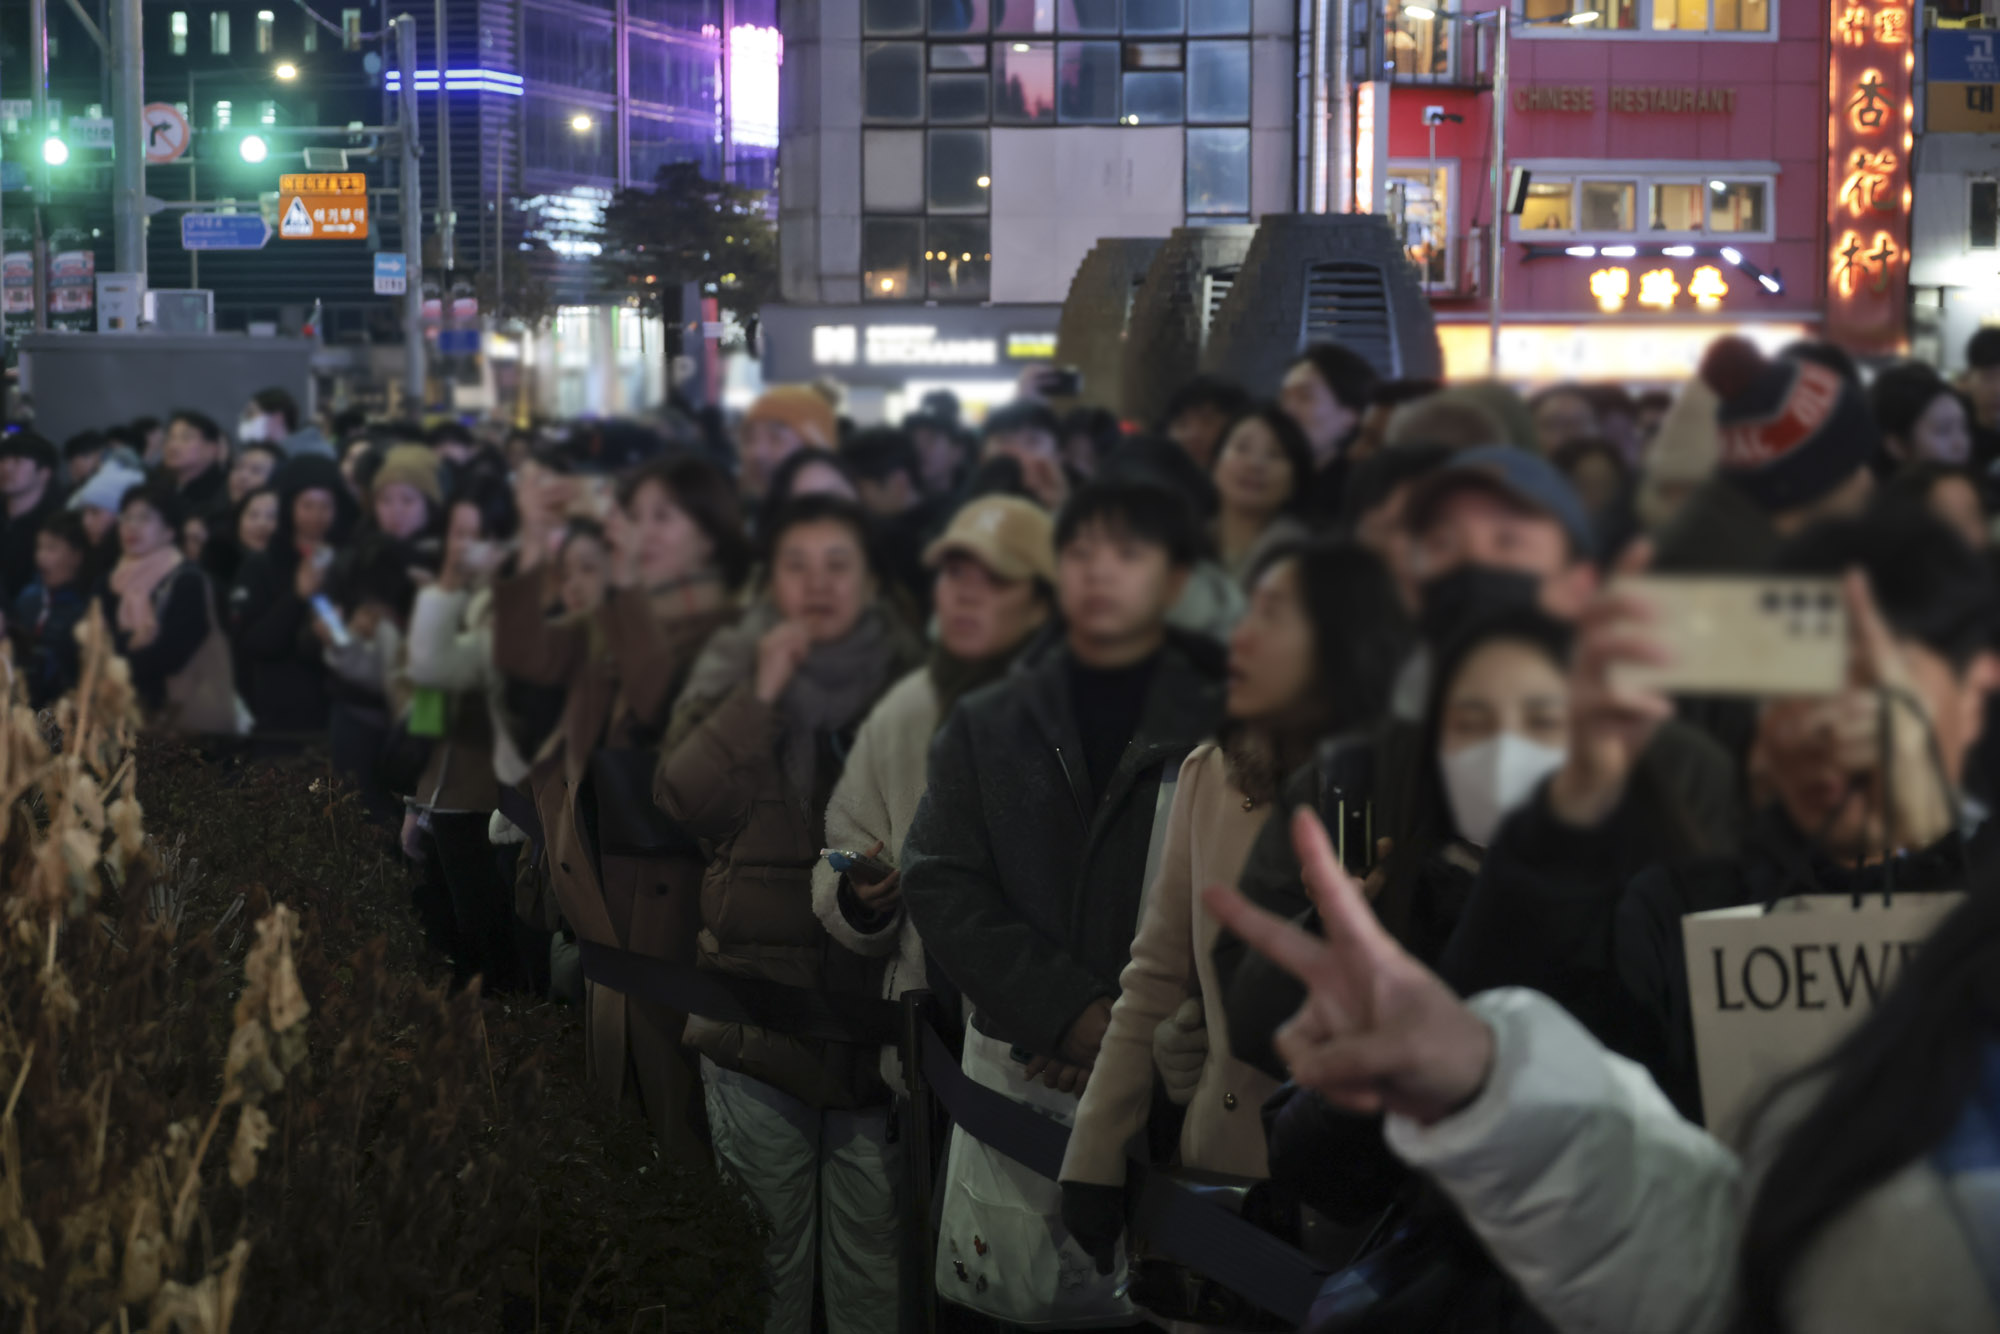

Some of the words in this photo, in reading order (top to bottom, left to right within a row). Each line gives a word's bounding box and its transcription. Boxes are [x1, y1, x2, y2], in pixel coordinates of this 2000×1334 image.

[1514, 86, 1595, 112] CHINESE
[1608, 87, 1737, 113] RESTAURANT
[1834, 70, 1899, 297] 杏花村
